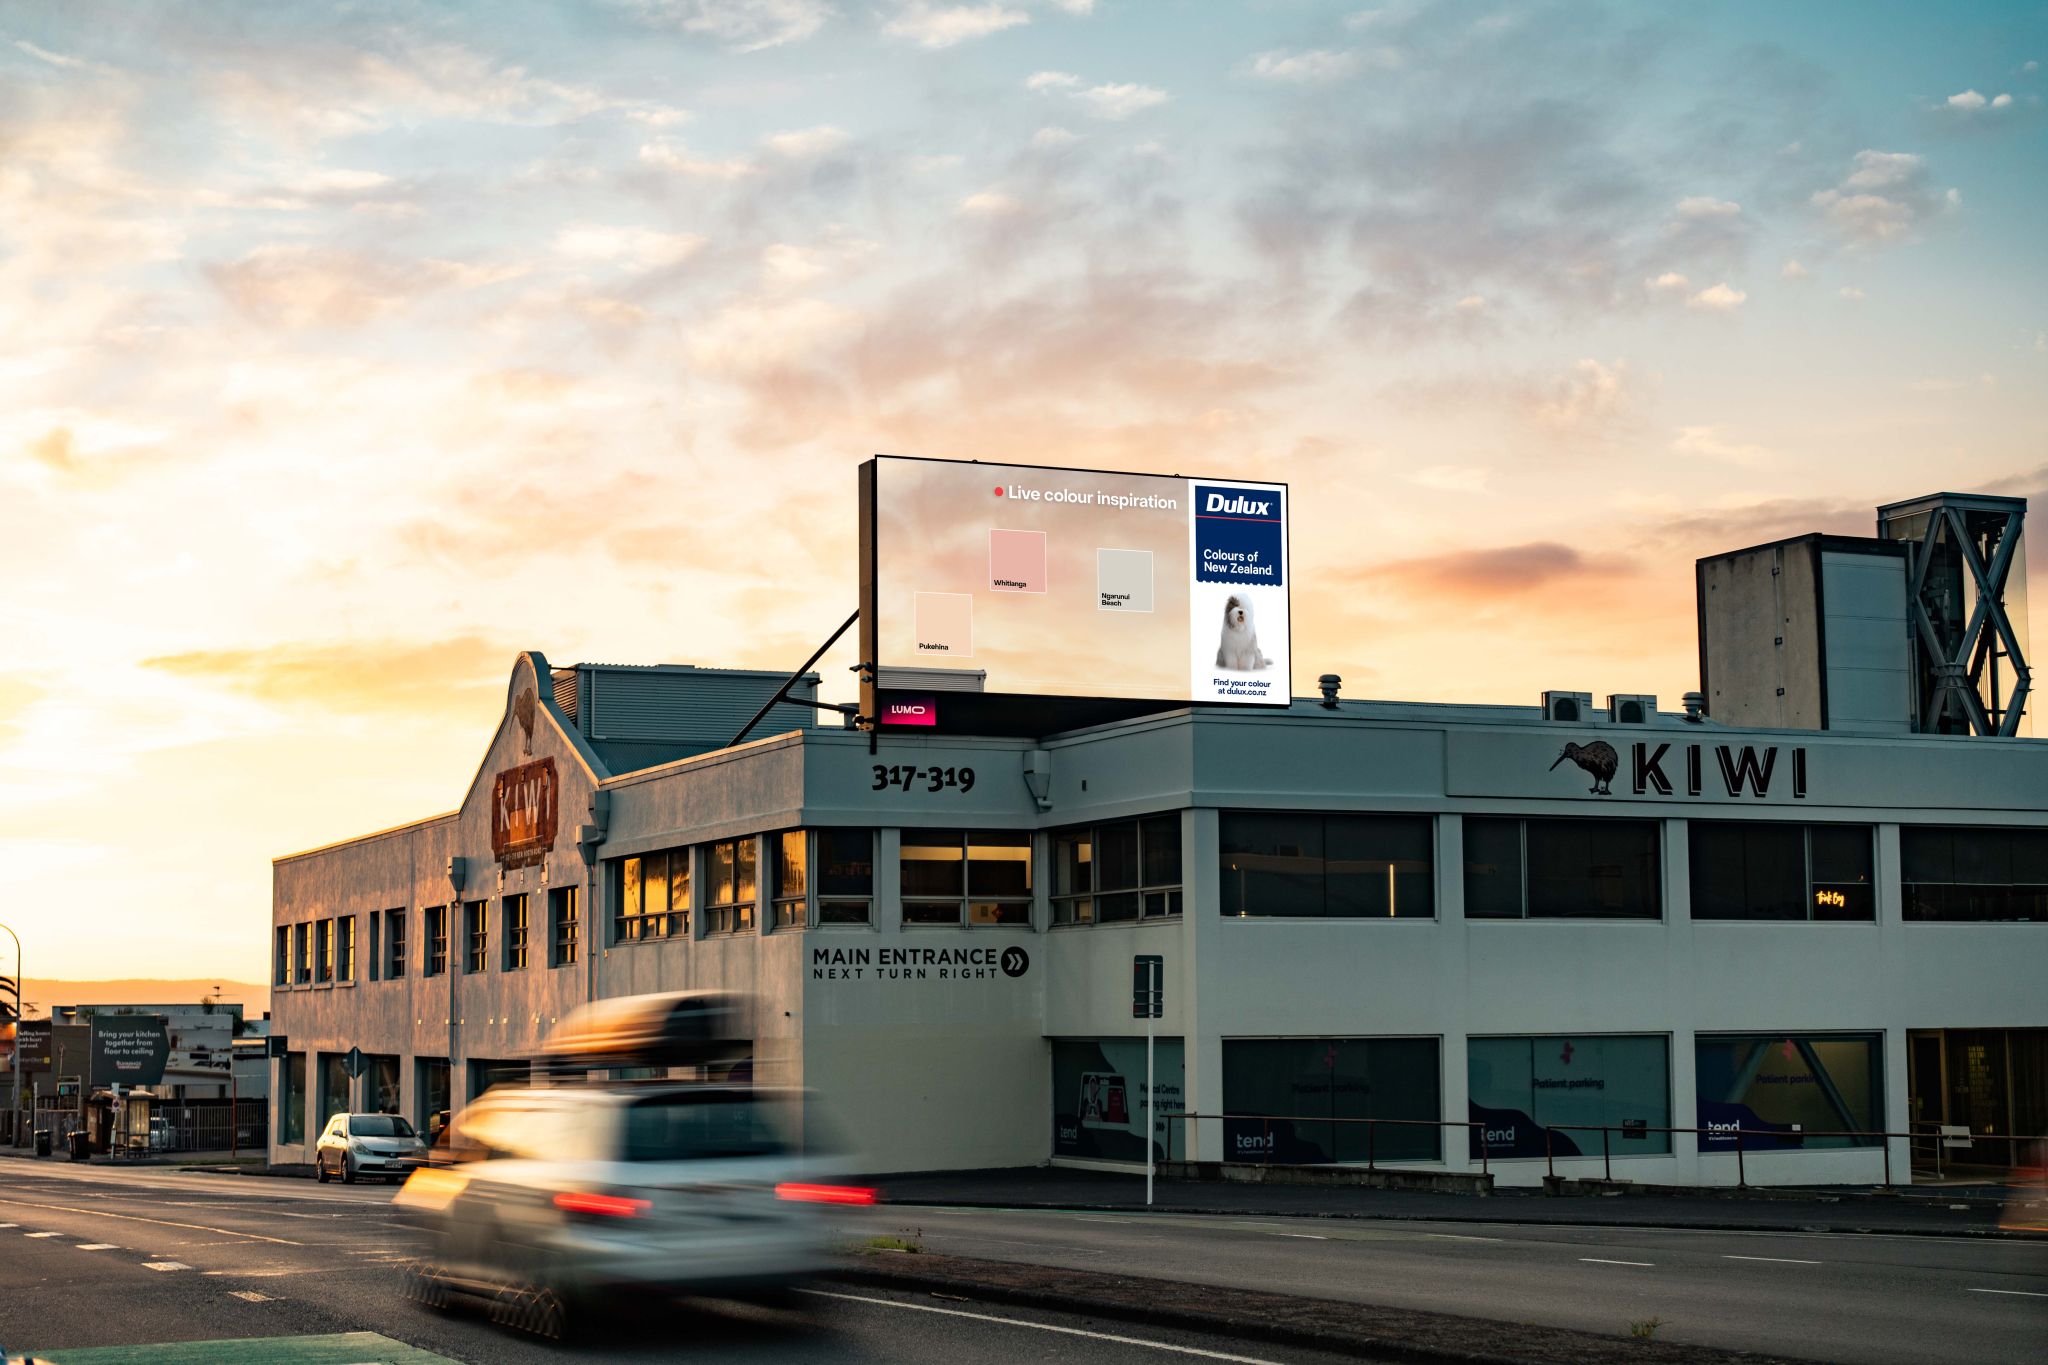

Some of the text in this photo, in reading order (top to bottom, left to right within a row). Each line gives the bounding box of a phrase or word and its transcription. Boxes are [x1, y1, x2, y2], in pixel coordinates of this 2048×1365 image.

[1008, 485, 1177, 510] Live colour inspiration
[1206, 493, 1270, 515] Dulux
[1203, 548, 1259, 562] Colours of
[1204, 561, 1272, 576] New Zealand
[919, 642, 949, 651] Pukehina
[1213, 678, 1271, 688] Find your colour
[1218, 687, 1267, 696] at dulux.co.nz
[891, 704, 926, 715] LUMO
[1632, 743, 1807, 799] KIWI
[872, 765, 975, 793] 317-319
[500, 774, 551, 833] KIWI
[813, 949, 997, 965] MAIN ENTRANCE
[814, 968, 997, 979] NEXT TURN RIGHT
[98, 1030, 117, 1039] Bring
[135, 1030, 160, 1038] kitchen
[105, 1039, 135, 1047] together
[104, 1047, 121, 1055] floor
[131, 1047, 154, 1056] ceiling
[1161, 1084, 1180, 1095] Centre
[1532, 1077, 1604, 1090] Patient parking
[1160, 1098, 1173, 1112] right
[1060, 1125, 1078, 1139] tend
[1708, 1120, 1740, 1135] tend
[1237, 1132, 1273, 1148] tend
